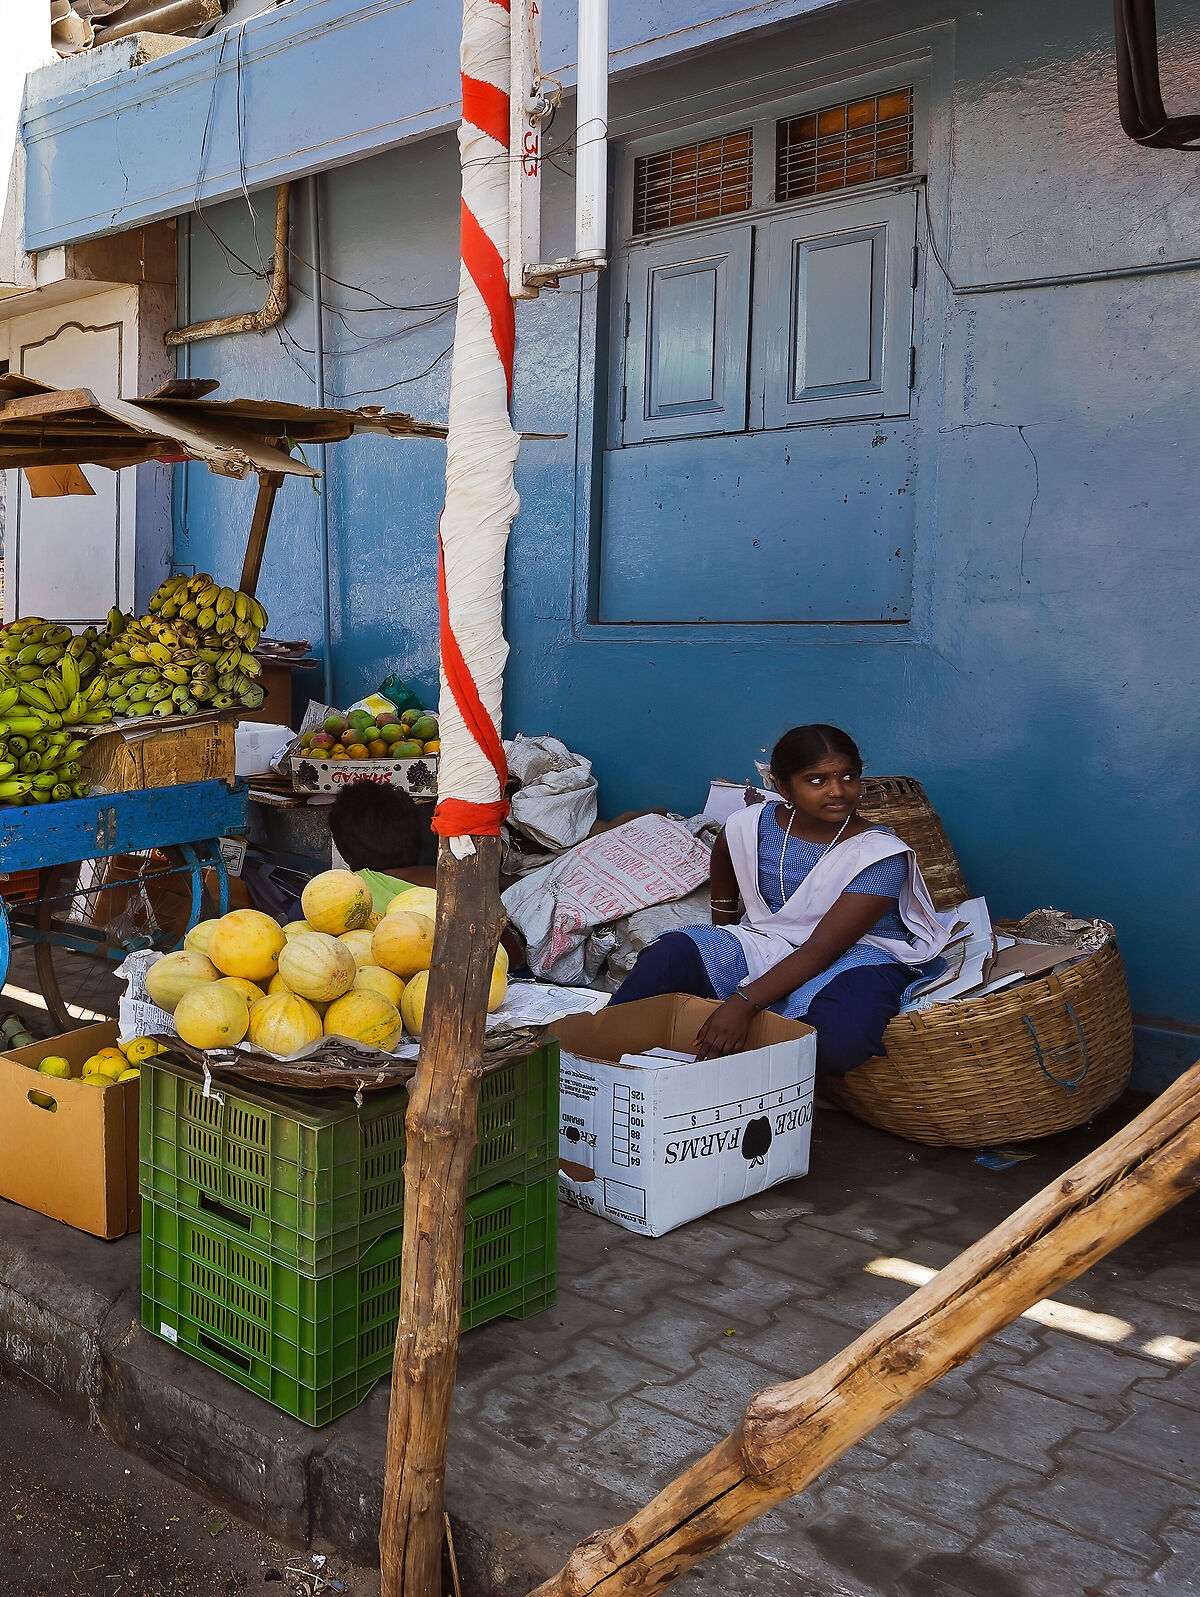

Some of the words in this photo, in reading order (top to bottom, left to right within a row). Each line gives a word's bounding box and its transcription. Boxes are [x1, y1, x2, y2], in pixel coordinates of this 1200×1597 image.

[631, 1091, 645, 1101] 125
[631, 1104, 645, 1114] 113
[691, 1085, 801, 1126] APPLES
[562, 1113, 585, 1127] BRAND
[631, 1117, 645, 1128] 100
[774, 1100, 813, 1136] CORE
[631, 1130, 641, 1140] 88
[631, 1143, 641, 1153] 72
[664, 1126, 742, 1164] FARMS
[630, 1156, 641, 1167] 64
[559, 1185, 595, 1202] APPLES
